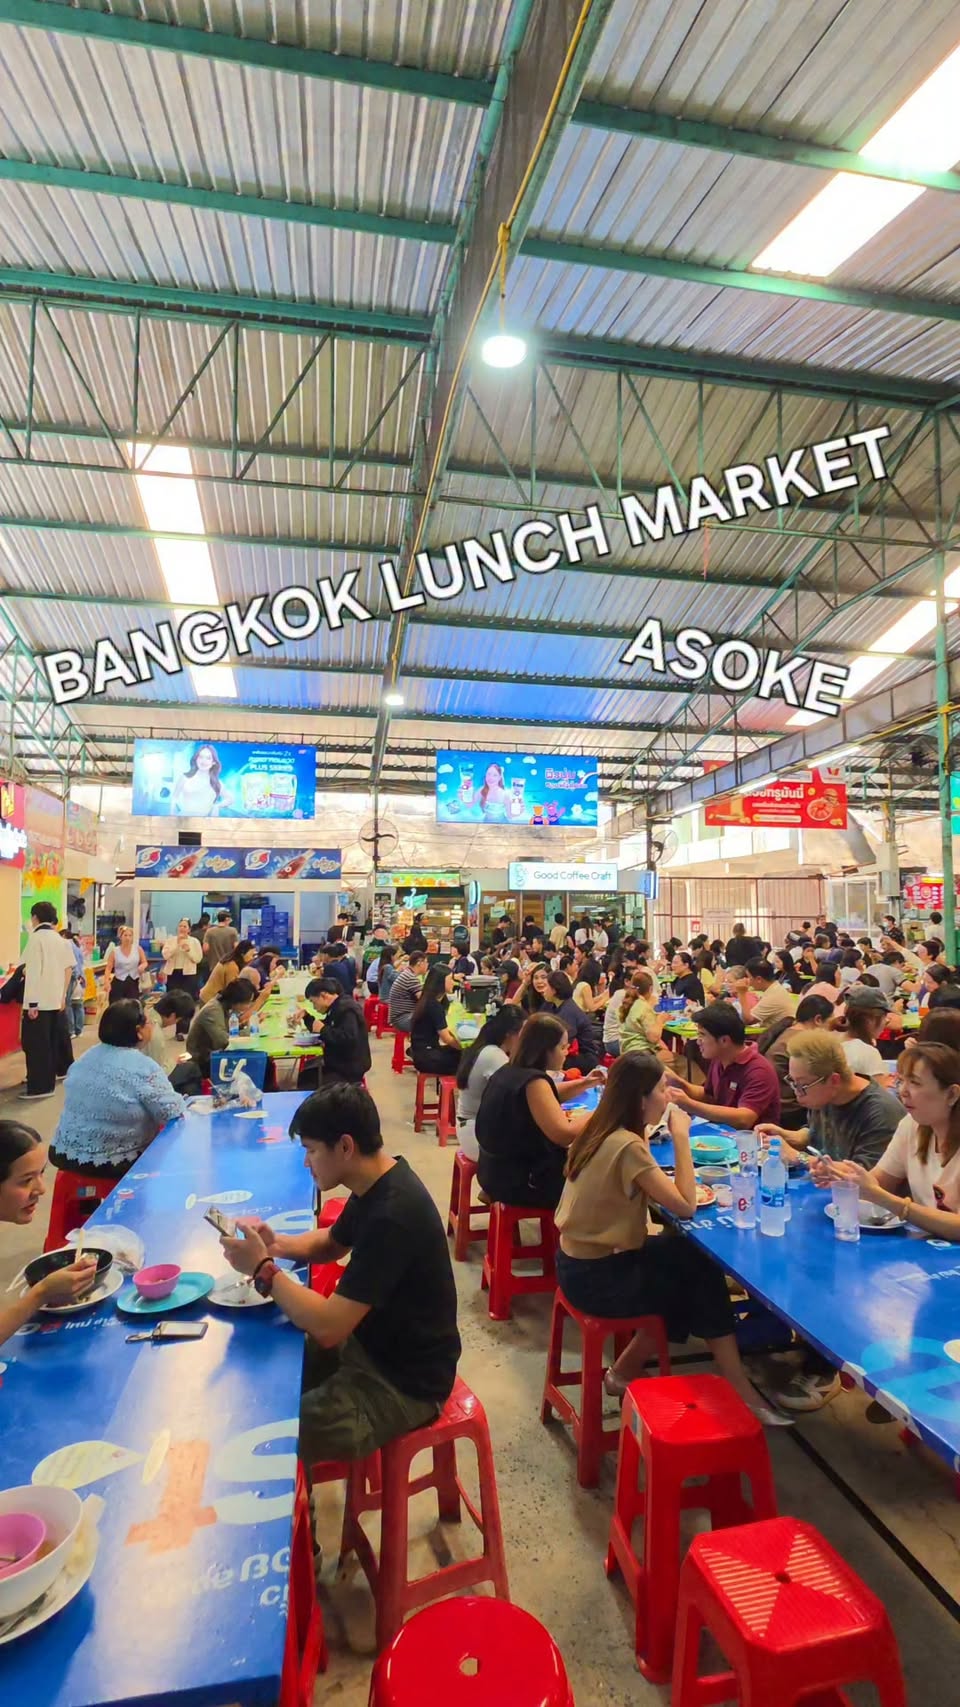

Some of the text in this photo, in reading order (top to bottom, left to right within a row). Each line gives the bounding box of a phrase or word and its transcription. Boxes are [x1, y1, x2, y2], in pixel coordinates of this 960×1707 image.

[534, 871, 611, 880] Good Coffee Craft
